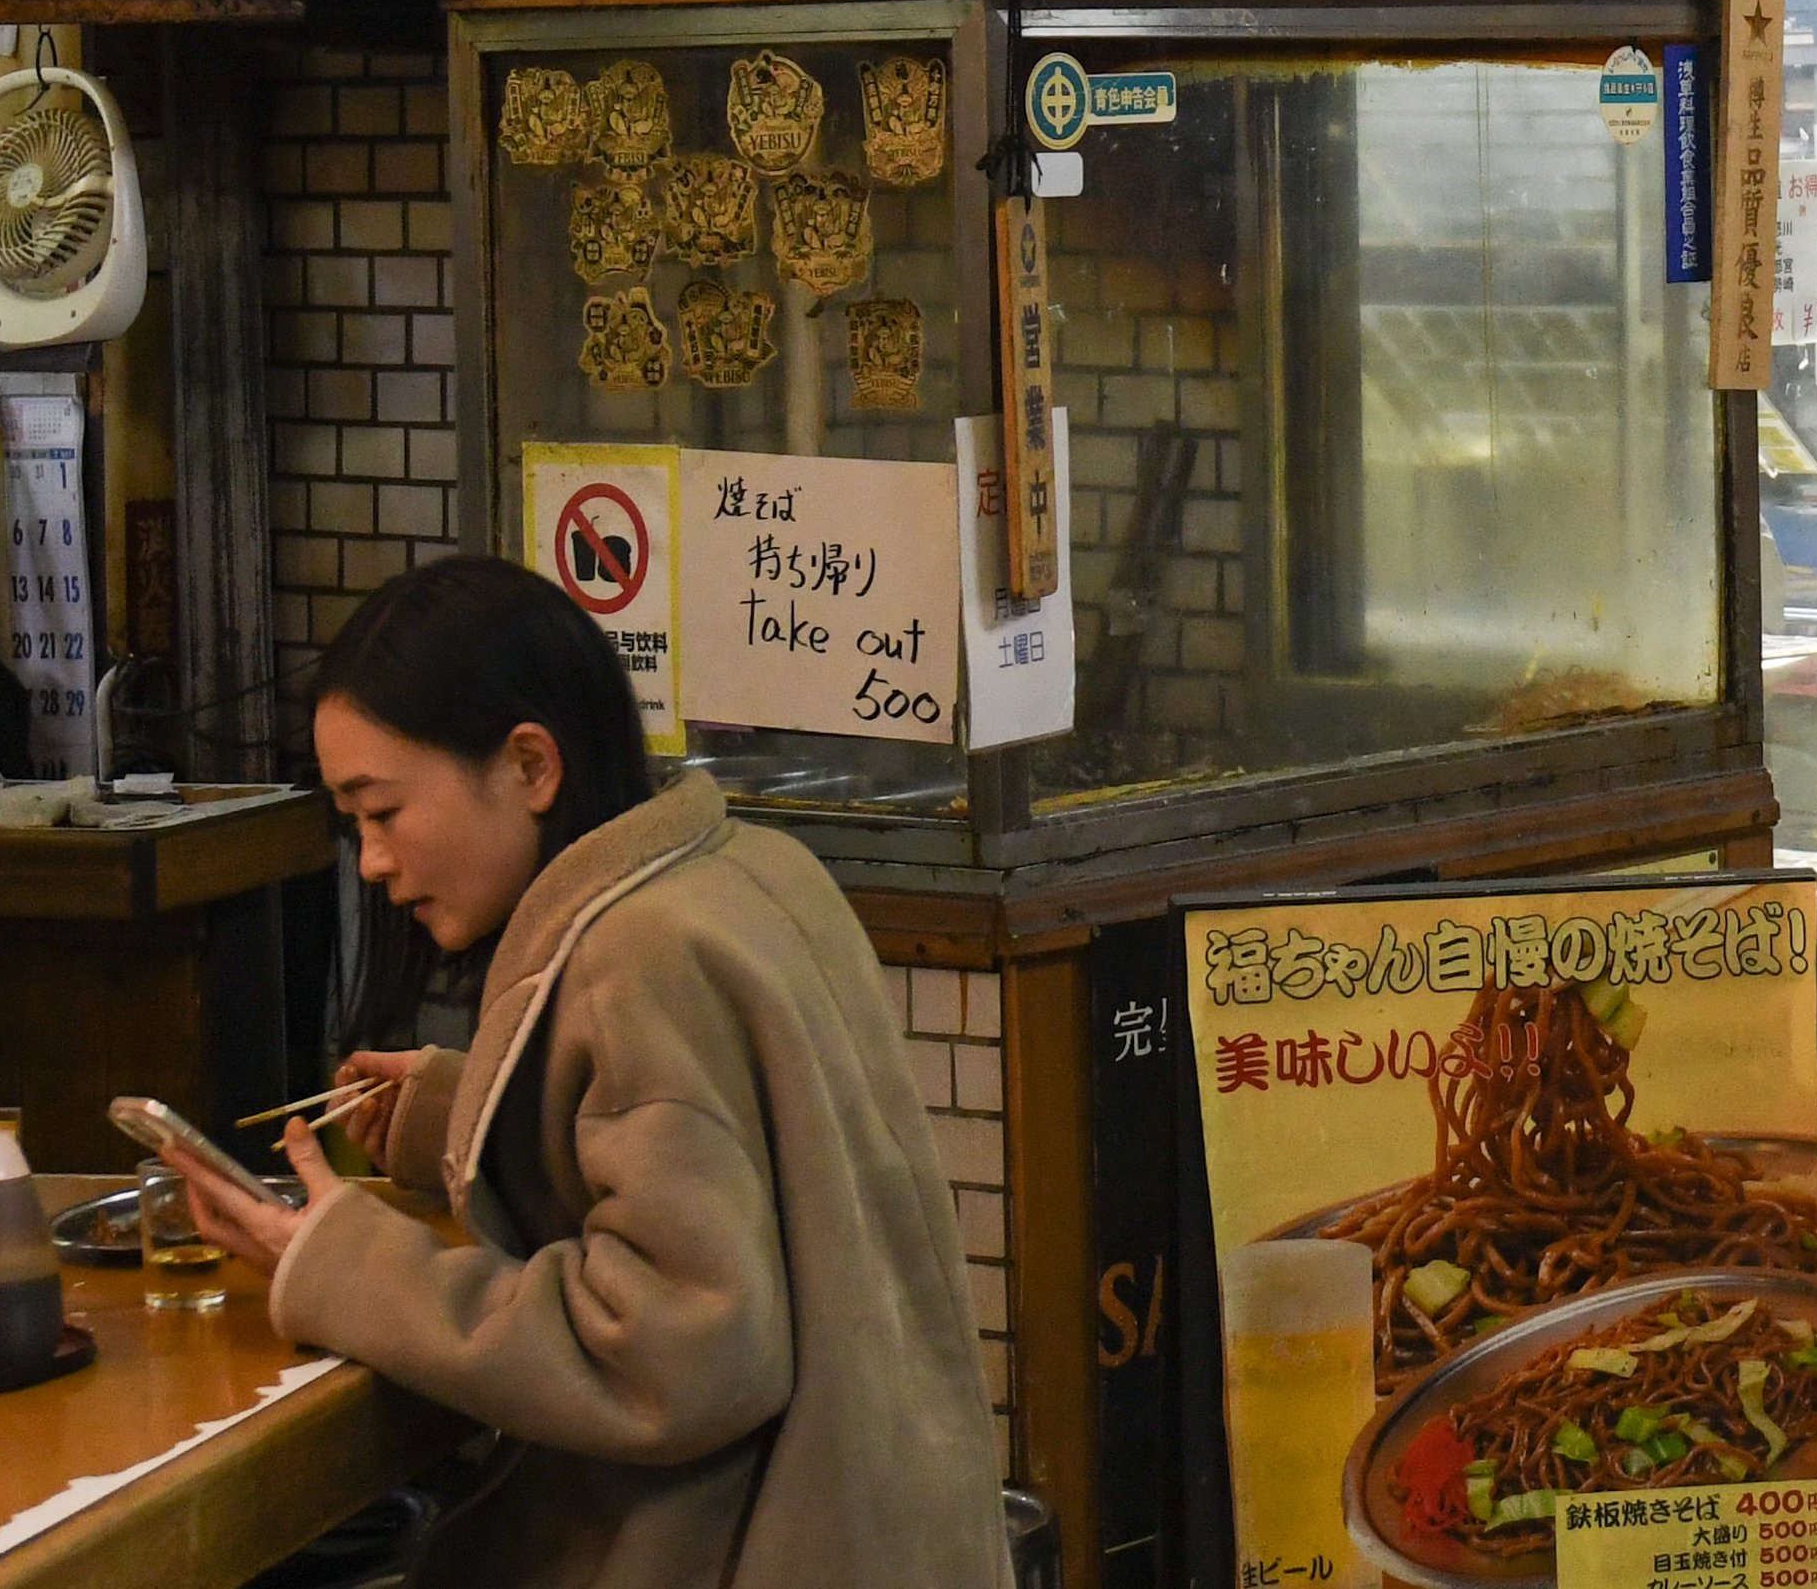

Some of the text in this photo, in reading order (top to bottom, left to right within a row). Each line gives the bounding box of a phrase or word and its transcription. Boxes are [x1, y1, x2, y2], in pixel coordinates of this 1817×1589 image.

[1094, 85, 1169, 111] 青色申告会員
[749, 131, 803, 151] YEBISU
[1022, 301, 1048, 537] 営業中
[60, 462, 68, 489] 1
[713, 476, 803, 523] 焼そば
[12, 519, 24, 547] 6
[38, 519, 48, 547] 7
[61, 519, 73, 547] 8
[747, 532, 877, 598] 持ち帰り
[11, 576, 29, 604] 13
[37, 577, 55, 604] 14
[63, 576, 81, 603] 15
[12, 632, 83, 660] 20 21 22
[855, 617, 926, 664] out
[997, 629, 1045, 669] 土曜日
[40, 689, 86, 717] 28 29
[852, 667, 942, 723] 500
[1205, 905, 1808, 1007] 福ちゃん自慢の焼そば!
[1214, 1019, 1543, 1095] 美味しいよ!!
[1566, 1494, 1721, 1530] 鉄板焼きそば
[1691, 1524, 1748, 1547] 大盛り
[1242, 1554, 1334, 1589] 生ビール
[1653, 1548, 1749, 1573] 目玉焼き付
